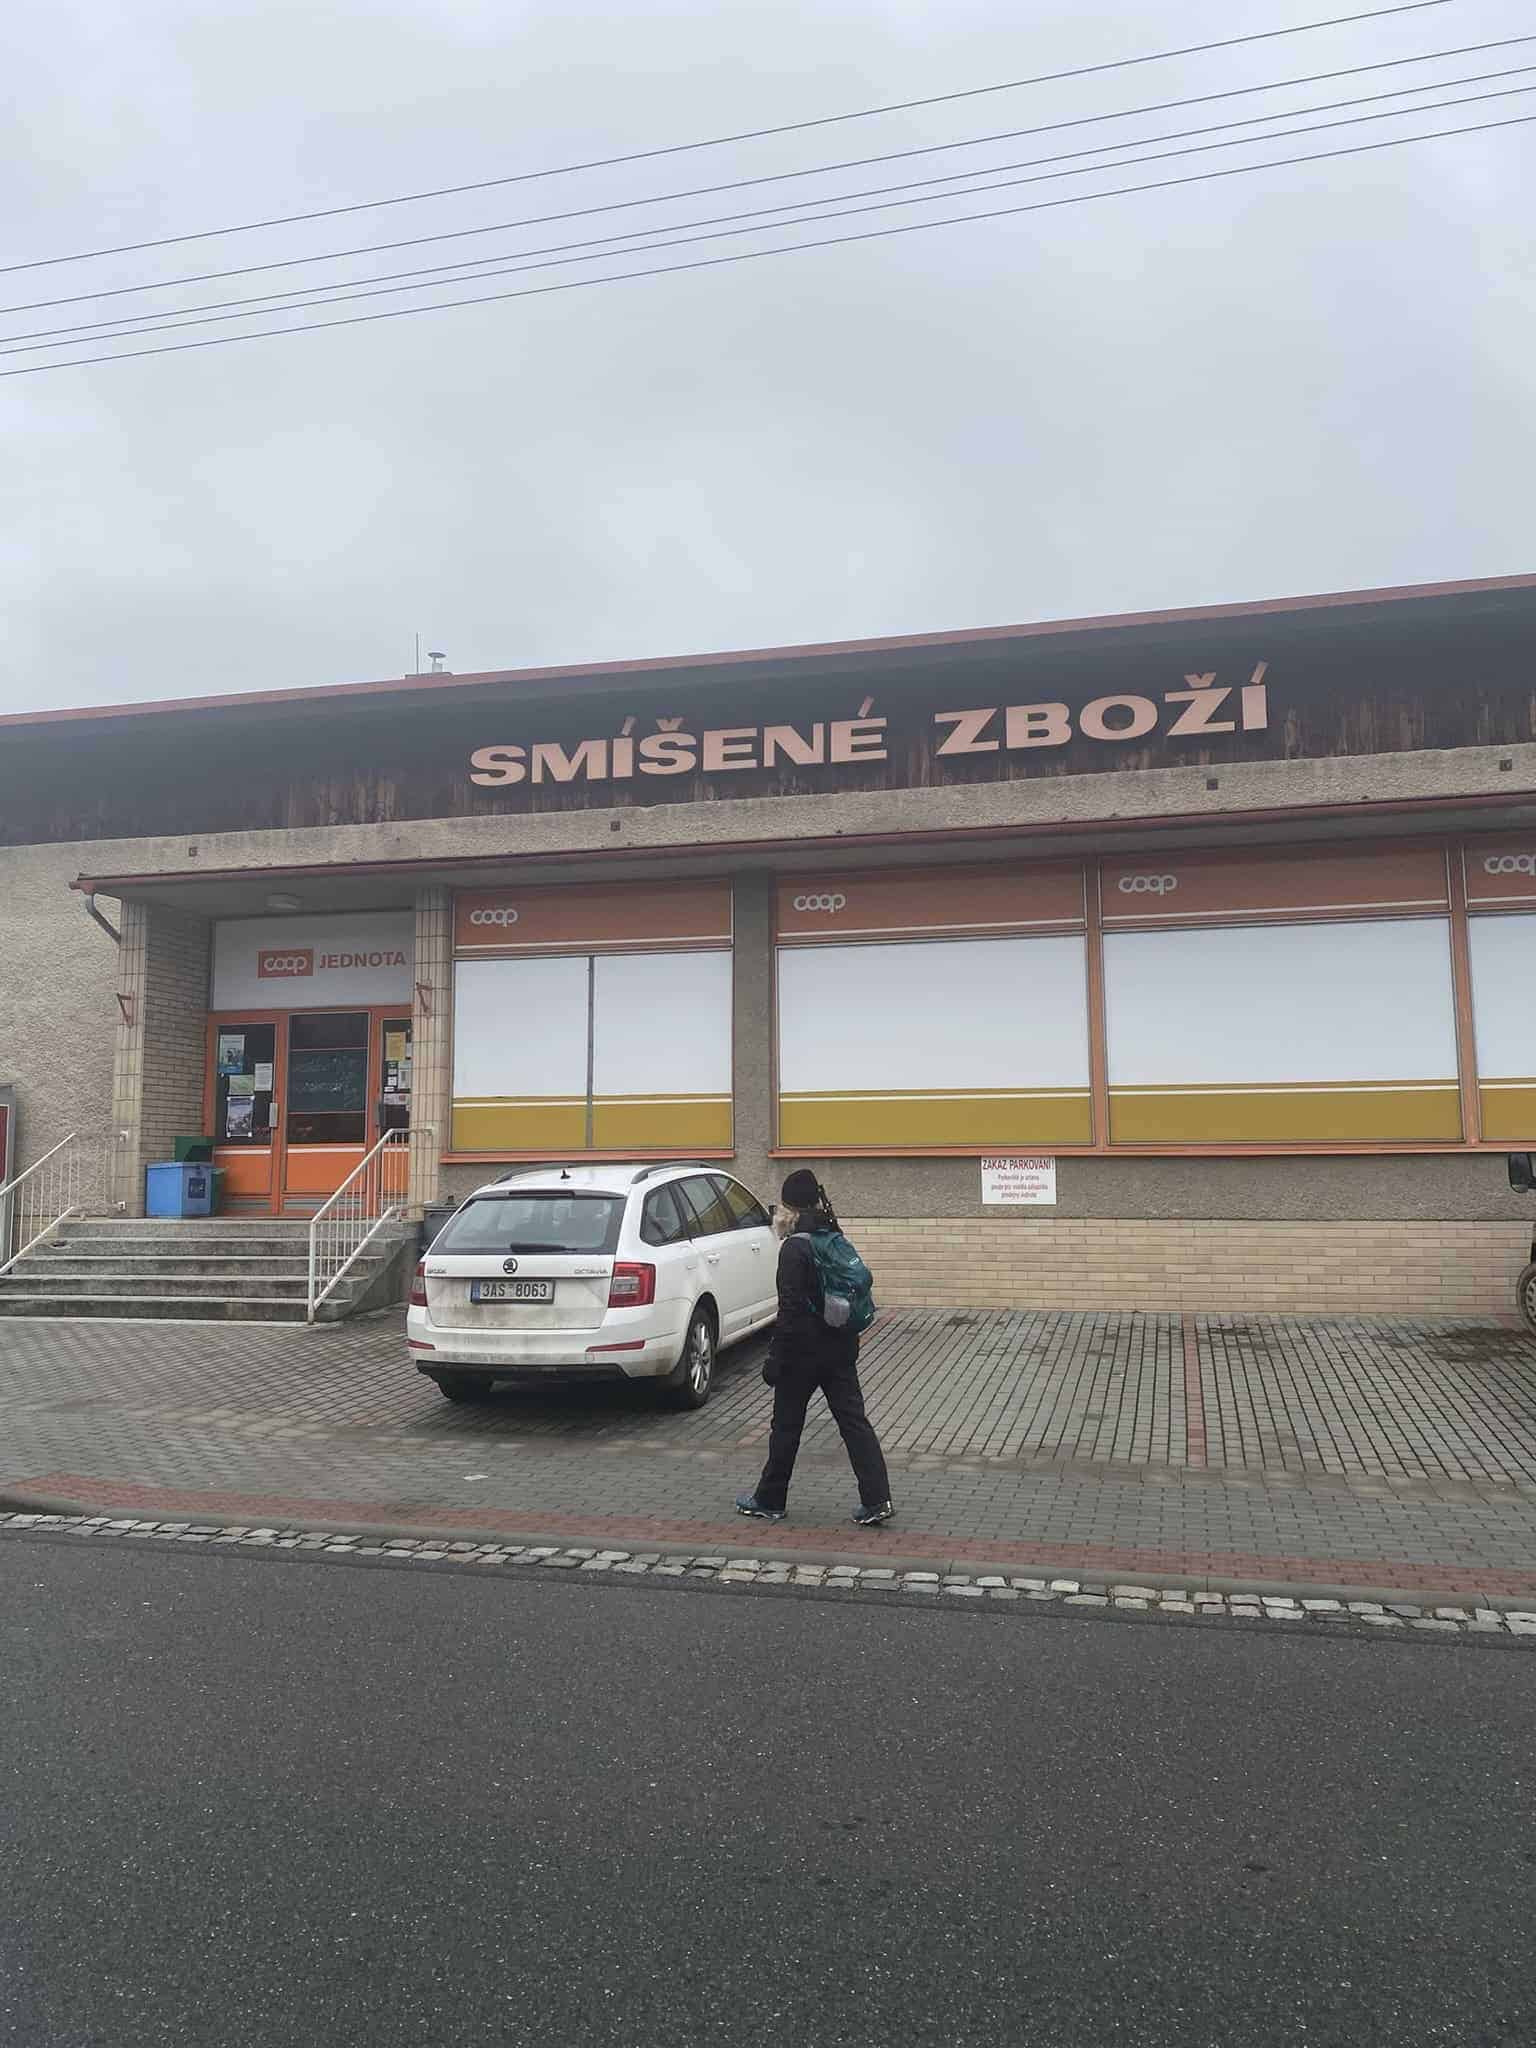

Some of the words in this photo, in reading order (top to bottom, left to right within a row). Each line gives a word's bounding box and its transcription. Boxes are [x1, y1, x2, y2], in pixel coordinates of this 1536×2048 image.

[470, 696, 888, 787] SMÍŠENÉ
[934, 660, 1268, 756] ZBOŽÍ
[1118, 874, 1178, 896] coop
[793, 894, 847, 913] coop
[470, 908, 519, 928] coop
[263, 955, 308, 975] coop
[319, 951, 407, 969] JEDNOTA
[482, 1283, 506, 1298] 3AS
[515, 1282, 548, 1298] 8063
